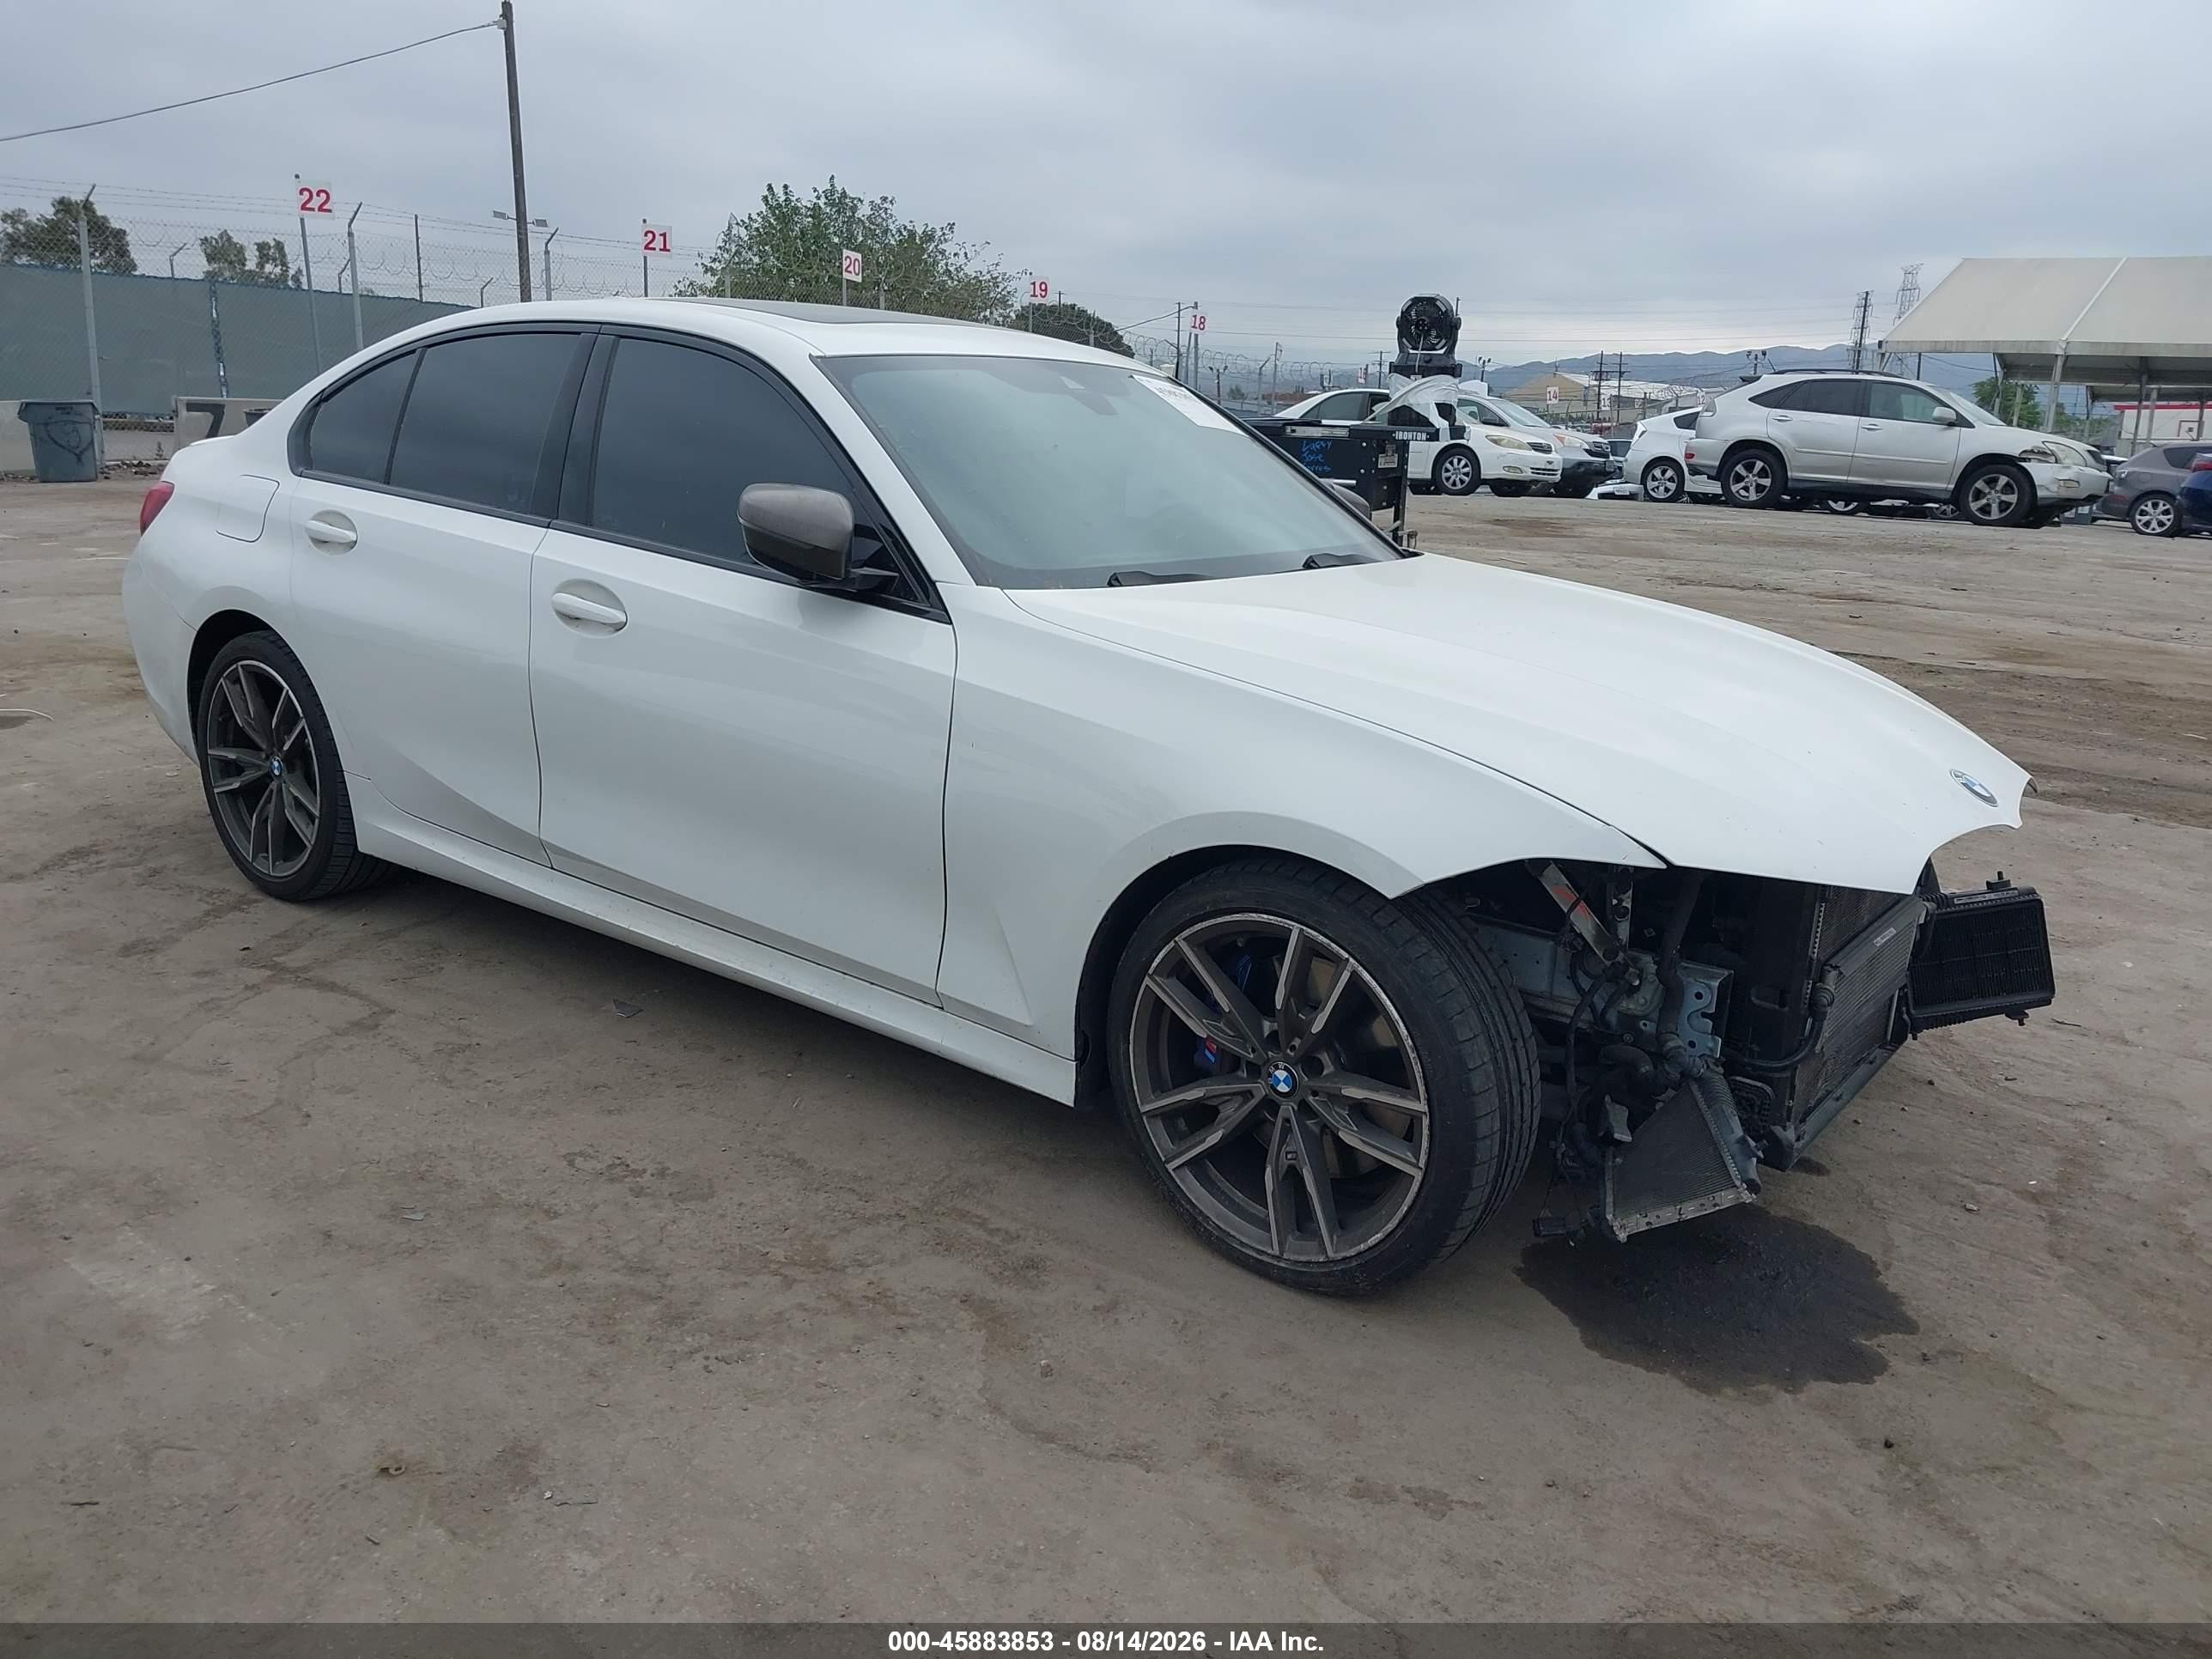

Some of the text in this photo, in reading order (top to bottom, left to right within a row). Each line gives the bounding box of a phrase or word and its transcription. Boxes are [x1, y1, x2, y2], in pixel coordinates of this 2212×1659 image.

[299, 187, 332, 214] 22
[644, 229, 671, 252] 21
[844, 255, 860, 276] 20
[1030, 281, 1048, 298] 19
[1191, 314, 1206, 331] 18
[1547, 390, 1559, 401] 14
[1395, 431, 1426, 441] IRONTON
